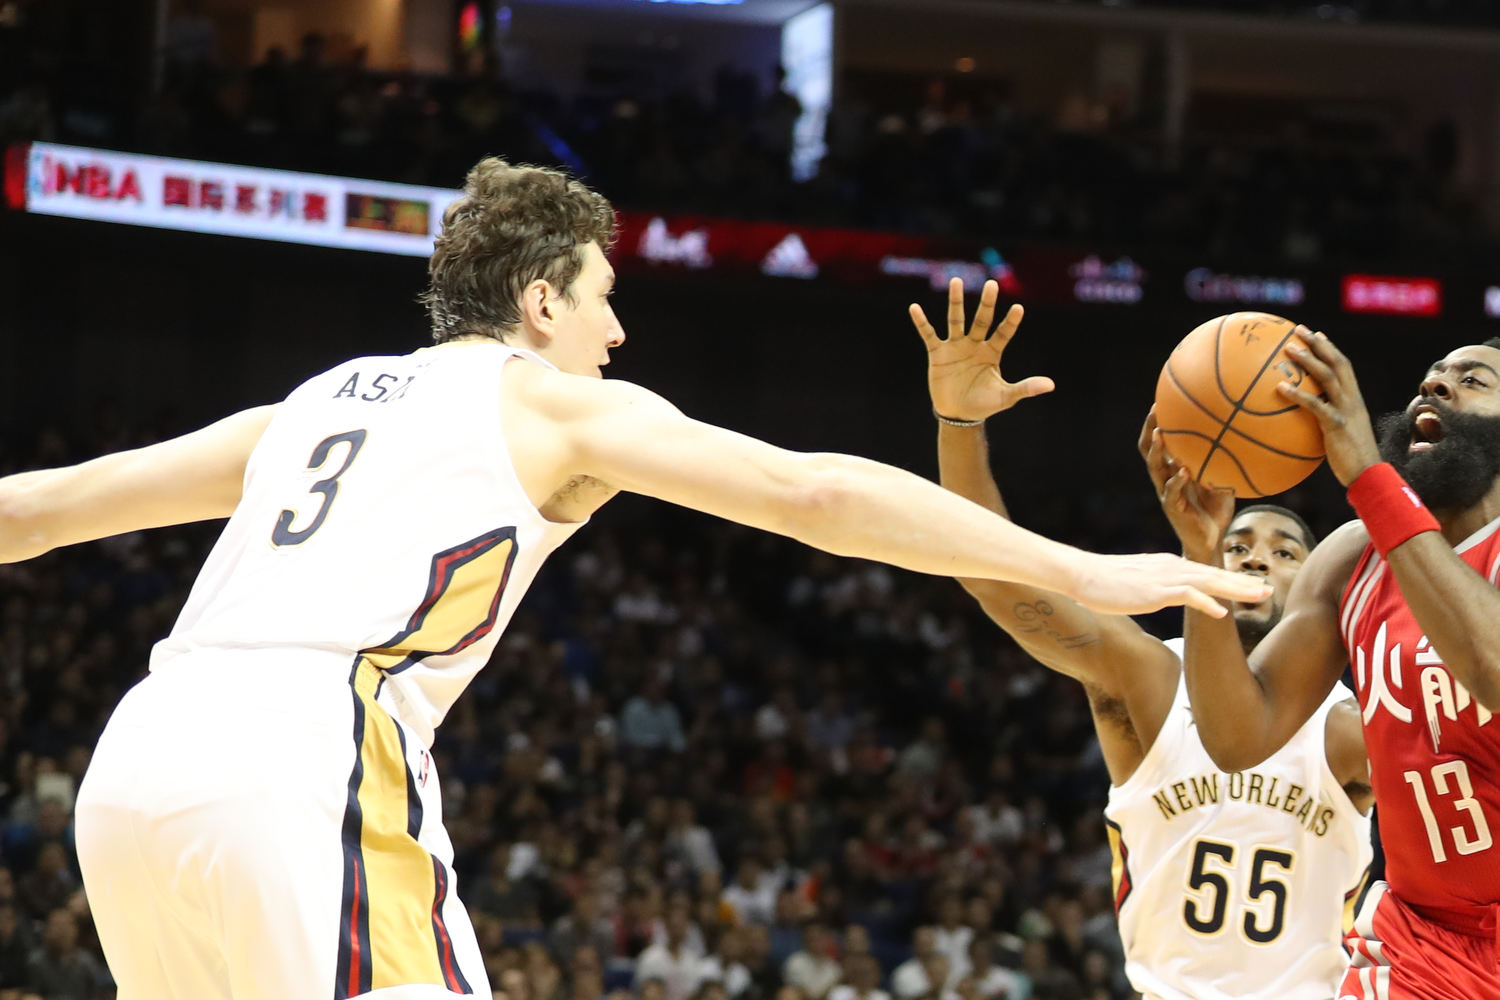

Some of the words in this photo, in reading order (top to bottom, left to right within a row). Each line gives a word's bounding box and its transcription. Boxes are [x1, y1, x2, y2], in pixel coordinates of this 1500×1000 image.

[56, 162, 142, 204] NBA
[270, 428, 367, 548] 3
[1152, 772, 1219, 821] NEW
[1403, 760, 1493, 864] 13
[1182, 839, 1294, 945] 55
